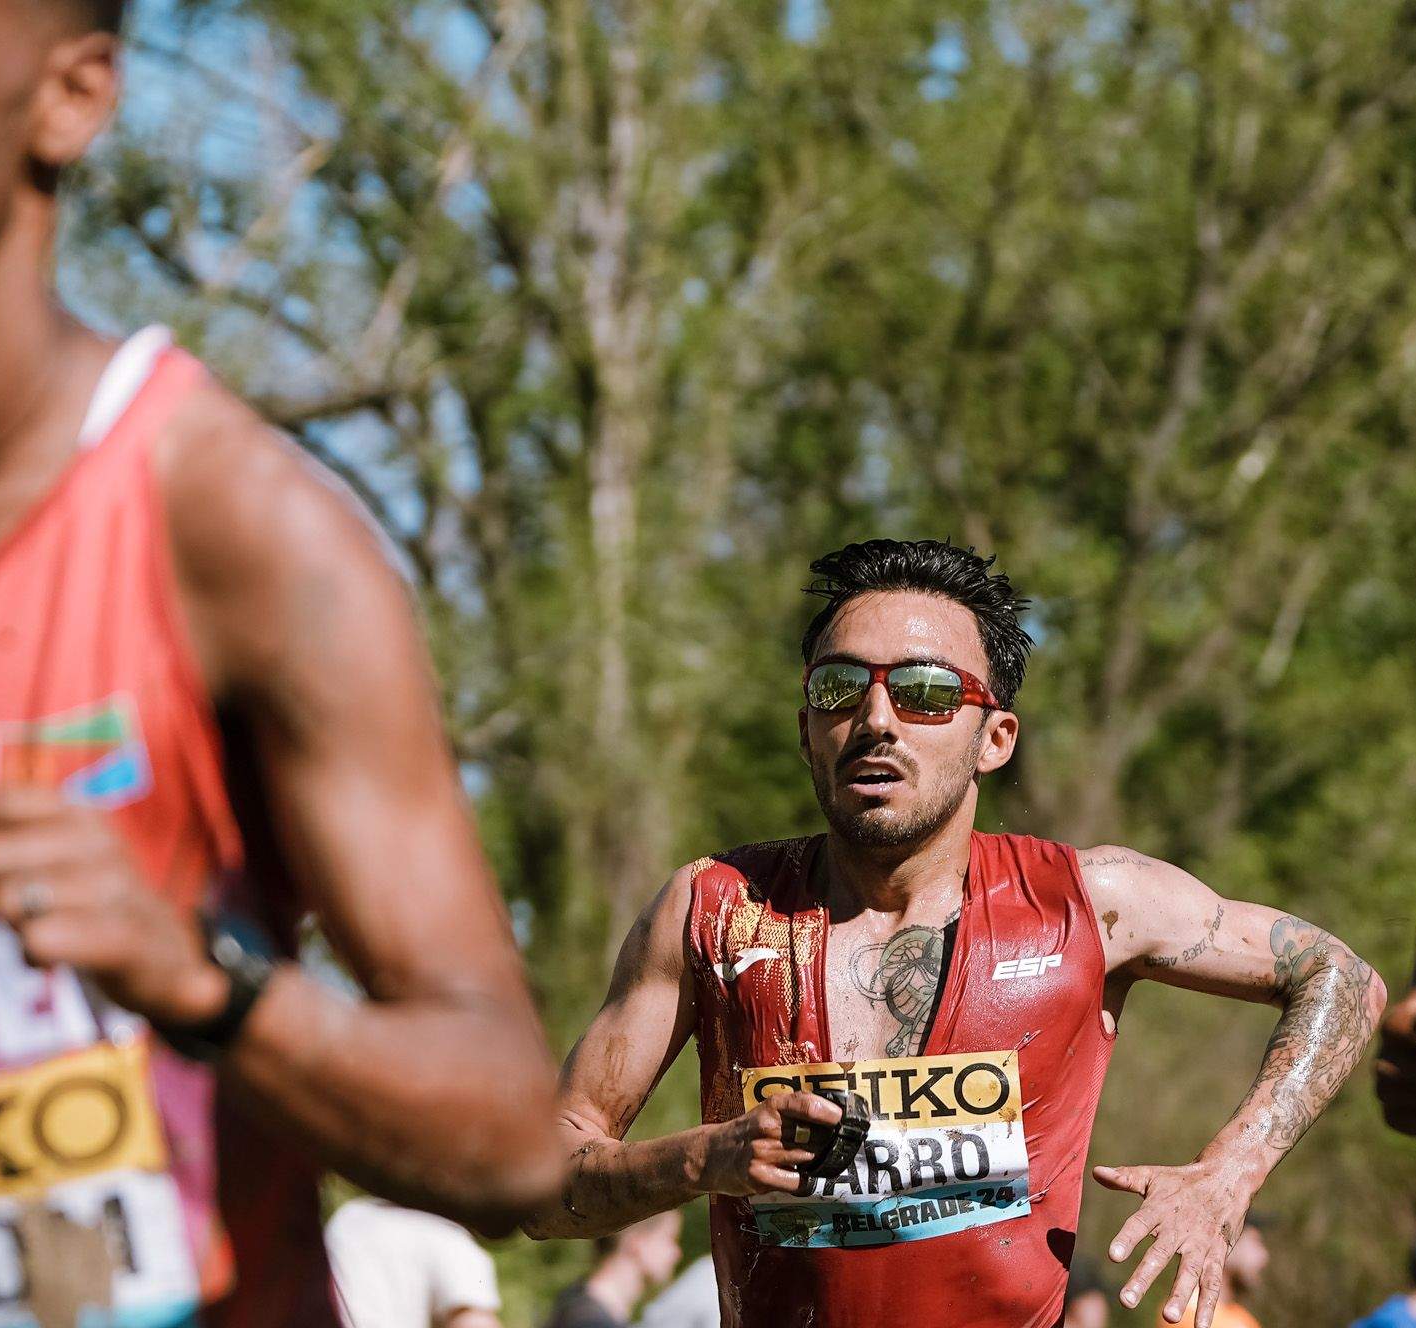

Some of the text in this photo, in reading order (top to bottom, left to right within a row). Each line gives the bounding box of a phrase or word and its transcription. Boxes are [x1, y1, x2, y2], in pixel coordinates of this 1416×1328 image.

[991, 953, 1063, 981] ESP
[800, 1132, 990, 1199] ARRO
[832, 1186, 1016, 1233] BELGRADE 24
